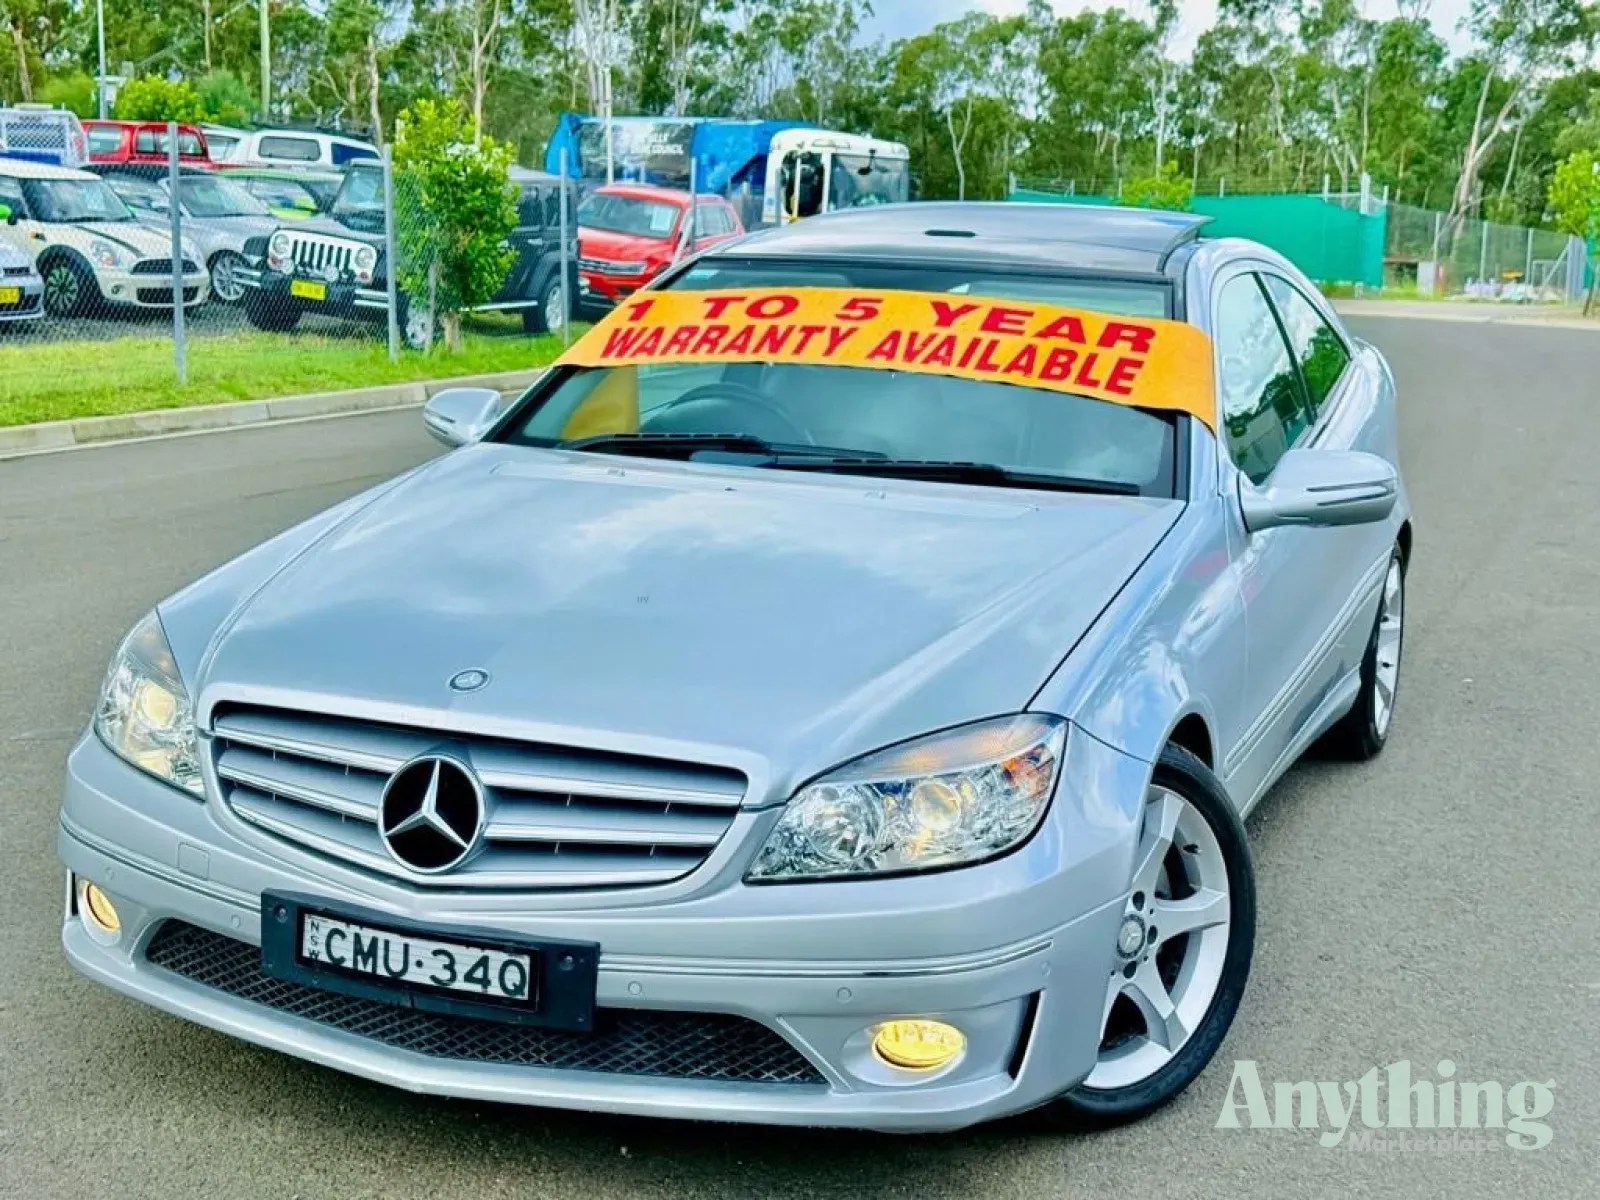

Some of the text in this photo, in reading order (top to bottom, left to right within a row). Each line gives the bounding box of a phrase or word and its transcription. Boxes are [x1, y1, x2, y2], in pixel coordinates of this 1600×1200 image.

[627, 295, 1157, 355] 1 TO 5 YEAR
[600, 324, 1146, 397] WARRANTY AVAILABLE
